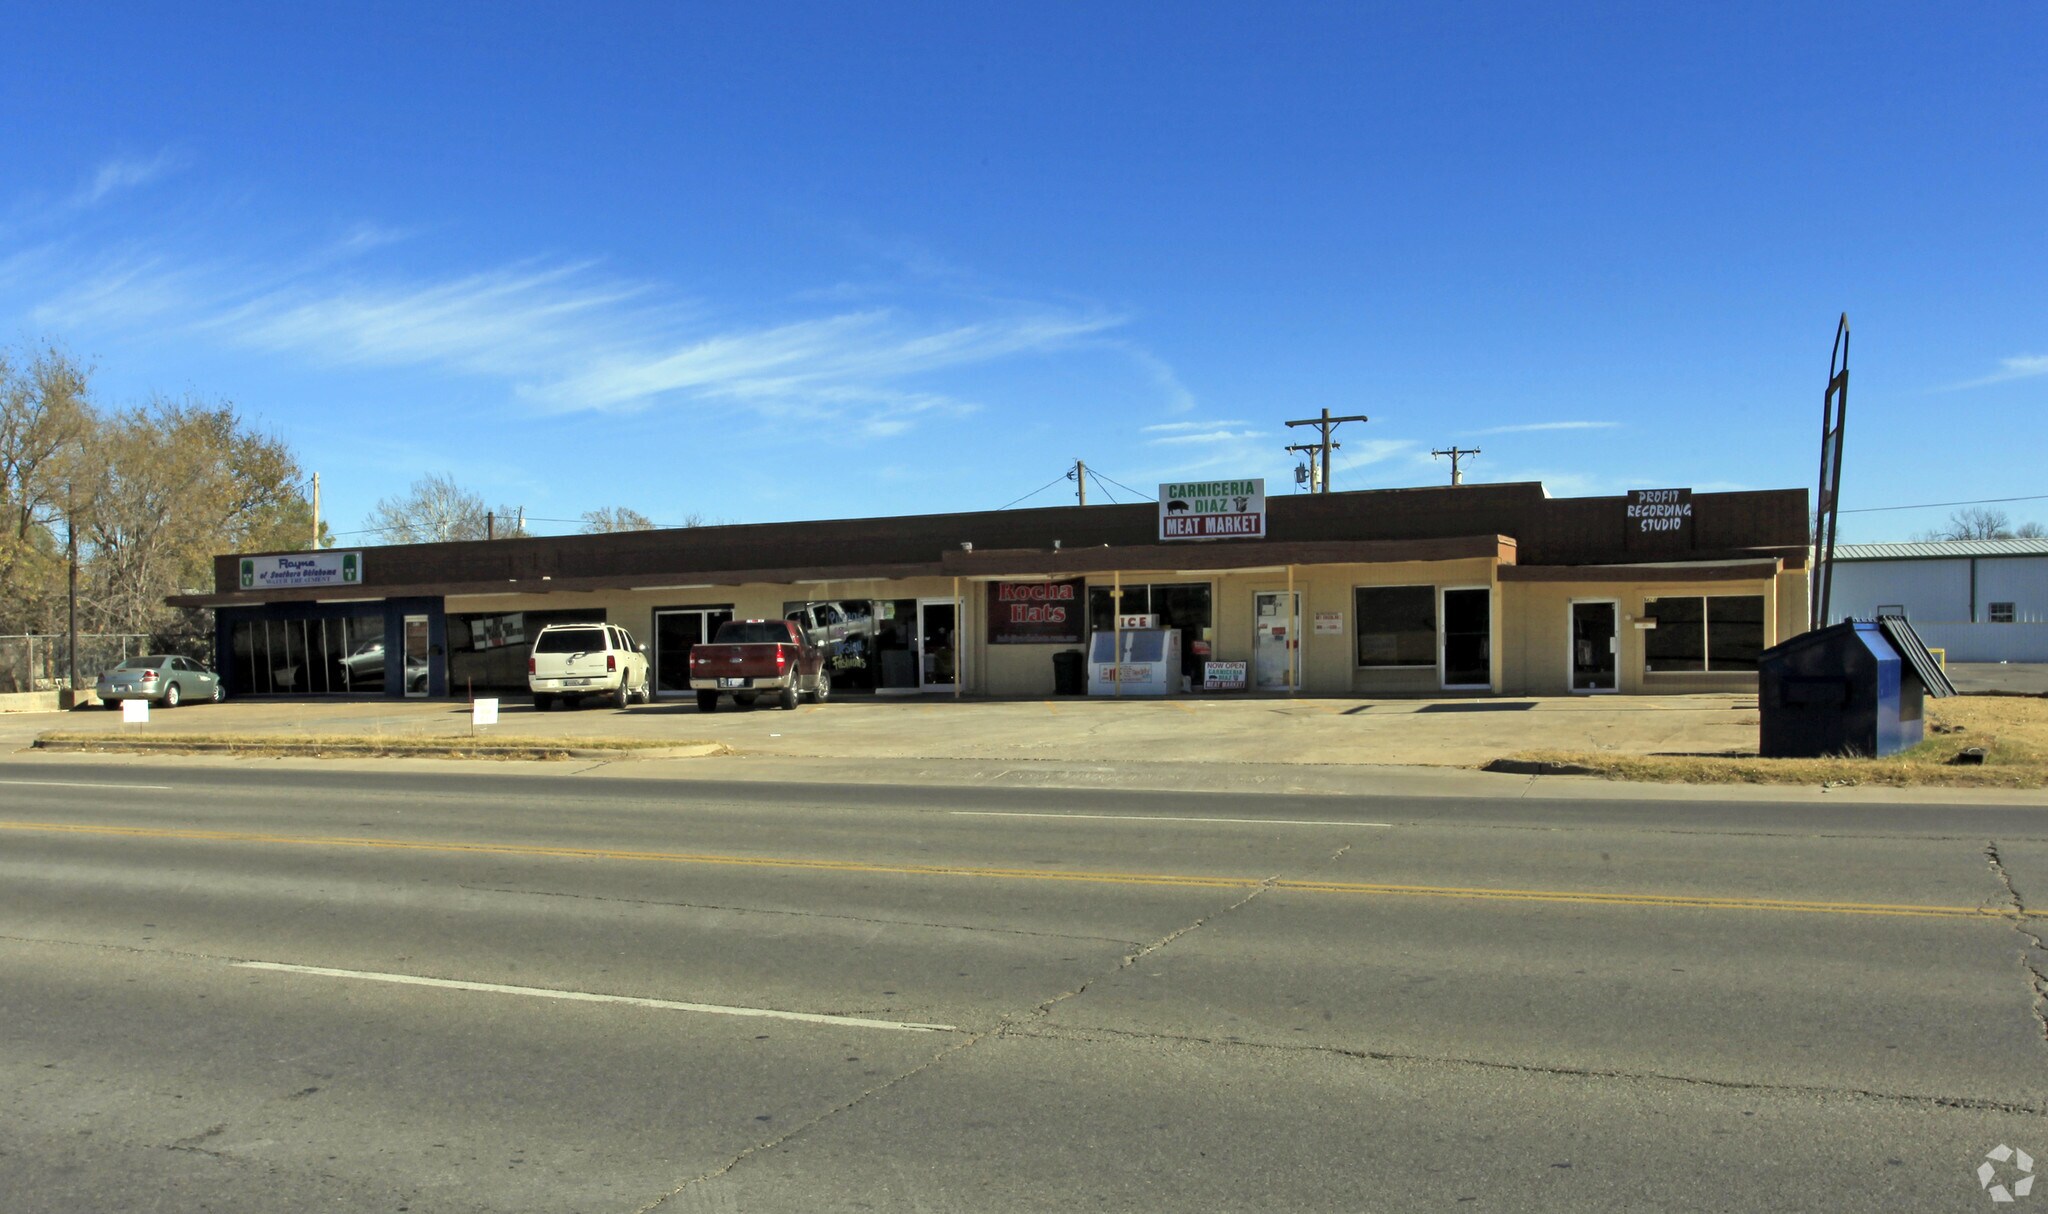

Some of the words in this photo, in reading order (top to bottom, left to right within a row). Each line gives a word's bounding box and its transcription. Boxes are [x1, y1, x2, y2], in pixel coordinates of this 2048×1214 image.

[1168, 481, 1254, 498] CARNICERIA
[1639, 491, 1679, 503] PROFIT
[1195, 499, 1228, 513] DIAZ
[1628, 504, 1691, 517] RECORDING
[1166, 517, 1200, 535] MEAT
[1205, 515, 1257, 533] MARKET
[1641, 518, 1681, 532] STUDIO
[260, 571, 267, 579] of
[270, 569, 301, 579] Southern
[303, 568, 337, 577] Oklahoma
[998, 581, 1075, 601] Rocha
[1010, 603, 1066, 623] Hats
[1120, 616, 1147, 628] ICE
